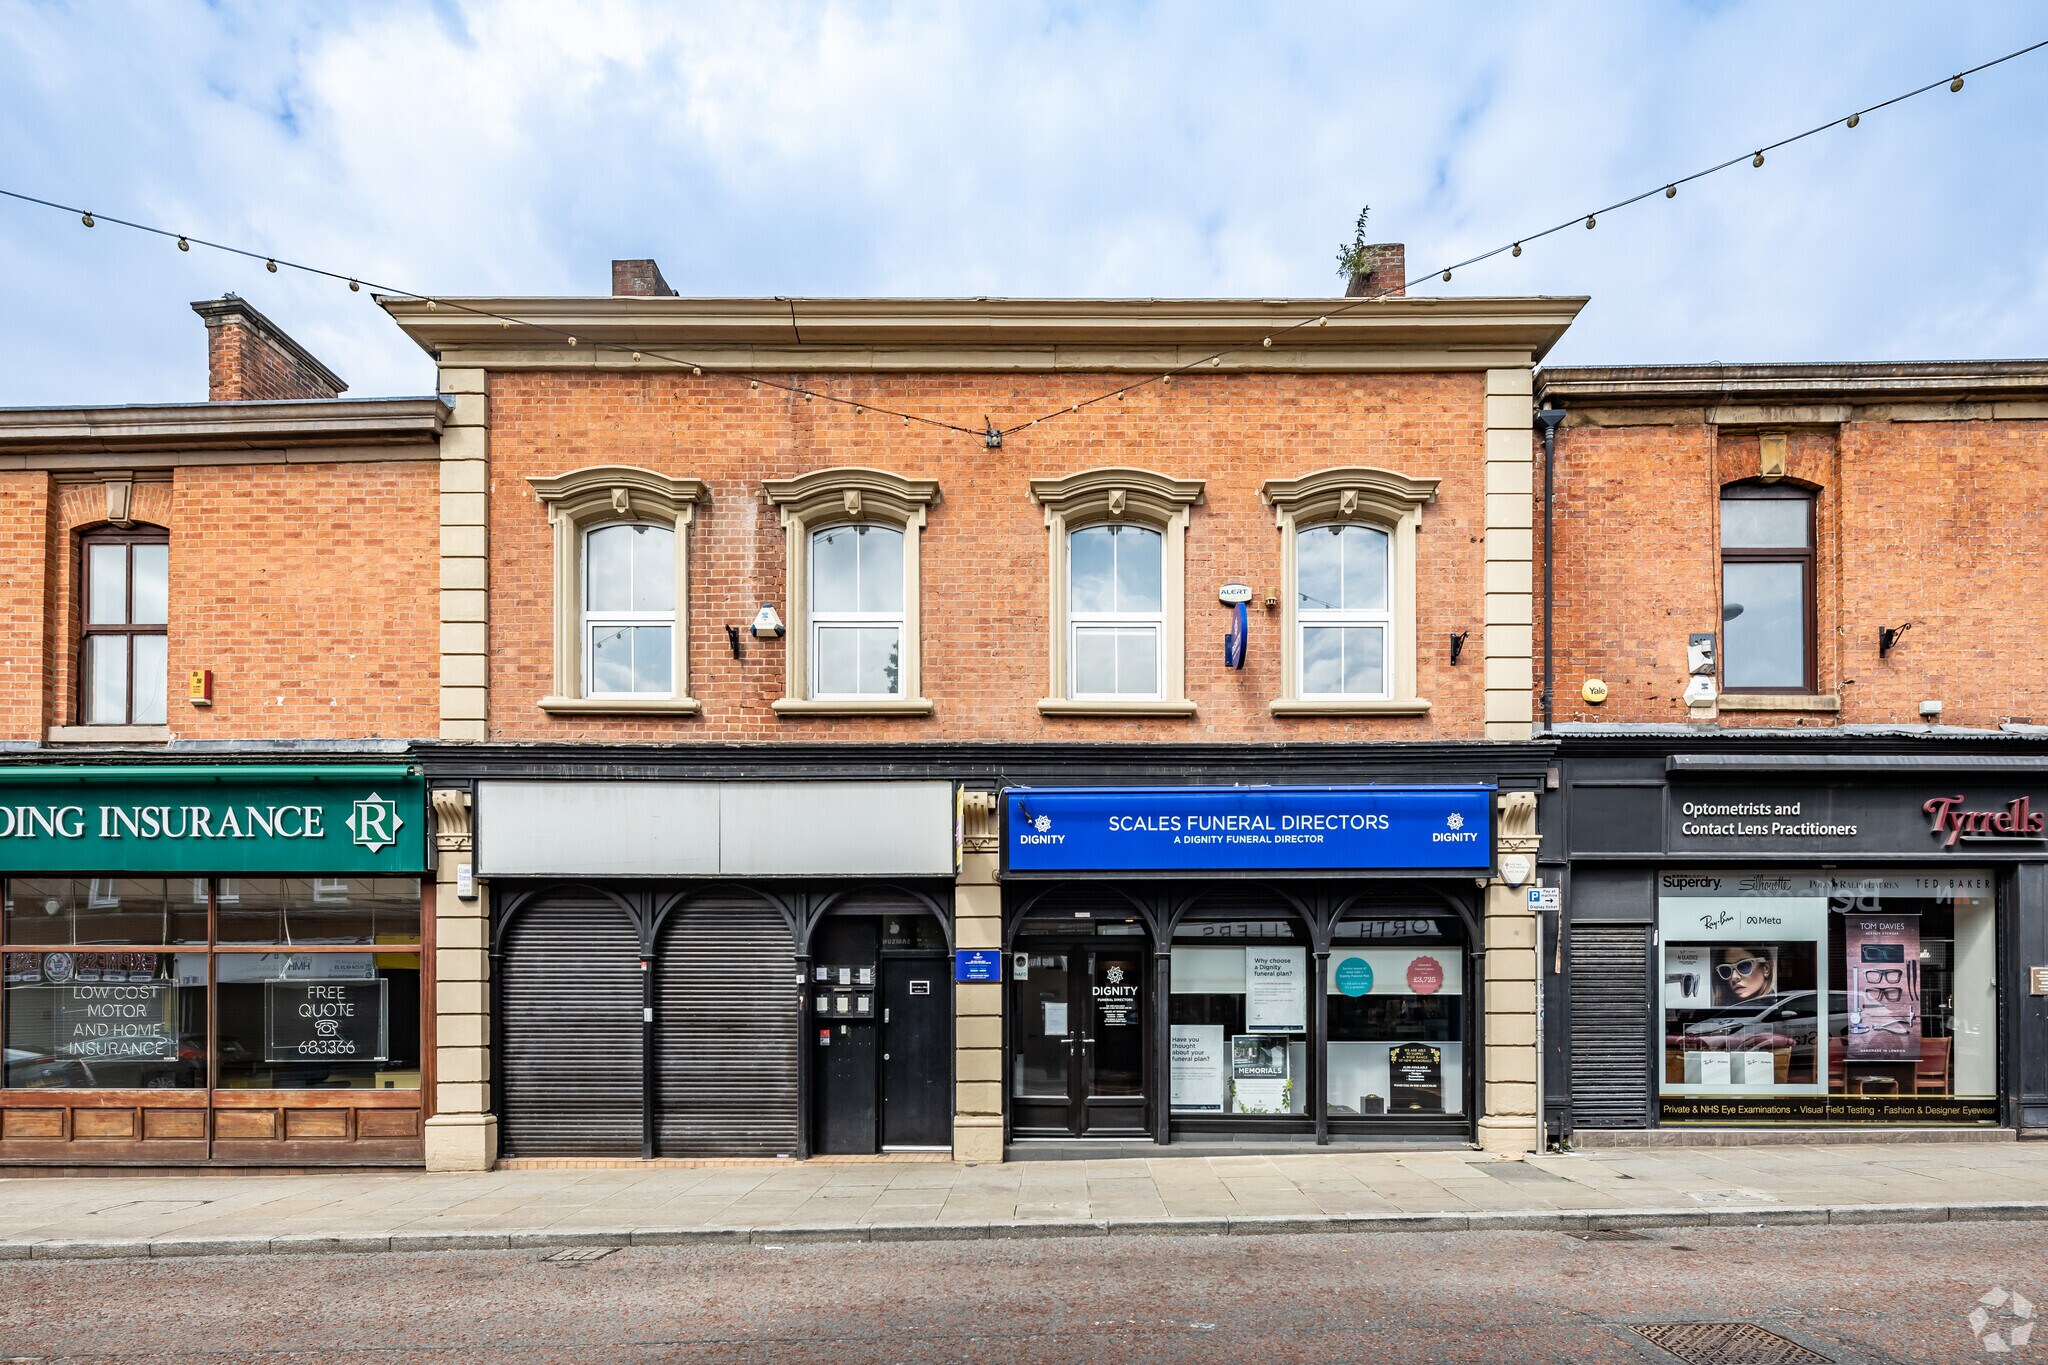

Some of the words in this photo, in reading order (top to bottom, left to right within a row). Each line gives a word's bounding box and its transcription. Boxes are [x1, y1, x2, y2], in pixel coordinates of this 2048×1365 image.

[1682, 802, 1771, 818] Optometrists
[1774, 802, 1800, 815] and
[99, 806, 324, 838] INSURANCE
[356, 804, 392, 841] R
[1109, 816, 1181, 831] SCALES
[1188, 815, 1275, 831] FUNERAL
[1282, 814, 1389, 830] DIRECTORS
[1922, 795, 2045, 846] Tyrrells
[1682, 822, 1734, 835] Contact
[1738, 822, 1768, 835] Lens
[1772, 822, 1857, 835] Practitioners
[1020, 835, 1065, 844] DIGNITY
[1174, 836, 1181, 844] A
[1184, 836, 1222, 844] DIGNITY
[1226, 835, 1272, 843] FUNERAL
[1274, 834, 1324, 843] DIRECTOR
[1432, 832, 1478, 842] DIGNITY
[1663, 876, 1722, 891] Superdry.
[1738, 874, 1792, 891] Silhouette
[1916, 879, 1939, 888] TED
[1950, 879, 1990, 888] BAKER
[74, 986, 108, 999] LOW
[114, 986, 158, 1000] COST
[307, 986, 346, 999] FREE
[1092, 986, 1138, 995] DIGNITY
[88, 1004, 146, 1017] MOTOR
[299, 1003, 355, 1017] QUOTE
[73, 1023, 108, 1037] AND
[114, 1023, 161, 1037] HOME
[70, 1042, 164, 1055] INSURANCE
[298, 1040, 355, 1054] 683366
[1664, 1105, 1690, 1113] Private
[1692, 1105, 1698, 1113] &
[1701, 1105, 1719, 1113] NHS
[1722, 1105, 1736, 1115] Eye
[1738, 1105, 1790, 1113] Examinations
[1800, 1106, 1823, 1114] Visual
[1826, 1106, 1844, 1114] Field
[1846, 1106, 1874, 1115] Testing
[1884, 1106, 1915, 1114] Fashion
[1917, 1106, 1923, 1114] &
[1926, 1106, 1960, 1115] Designer
[1963, 1106, 1996, 1115] Eyewear
